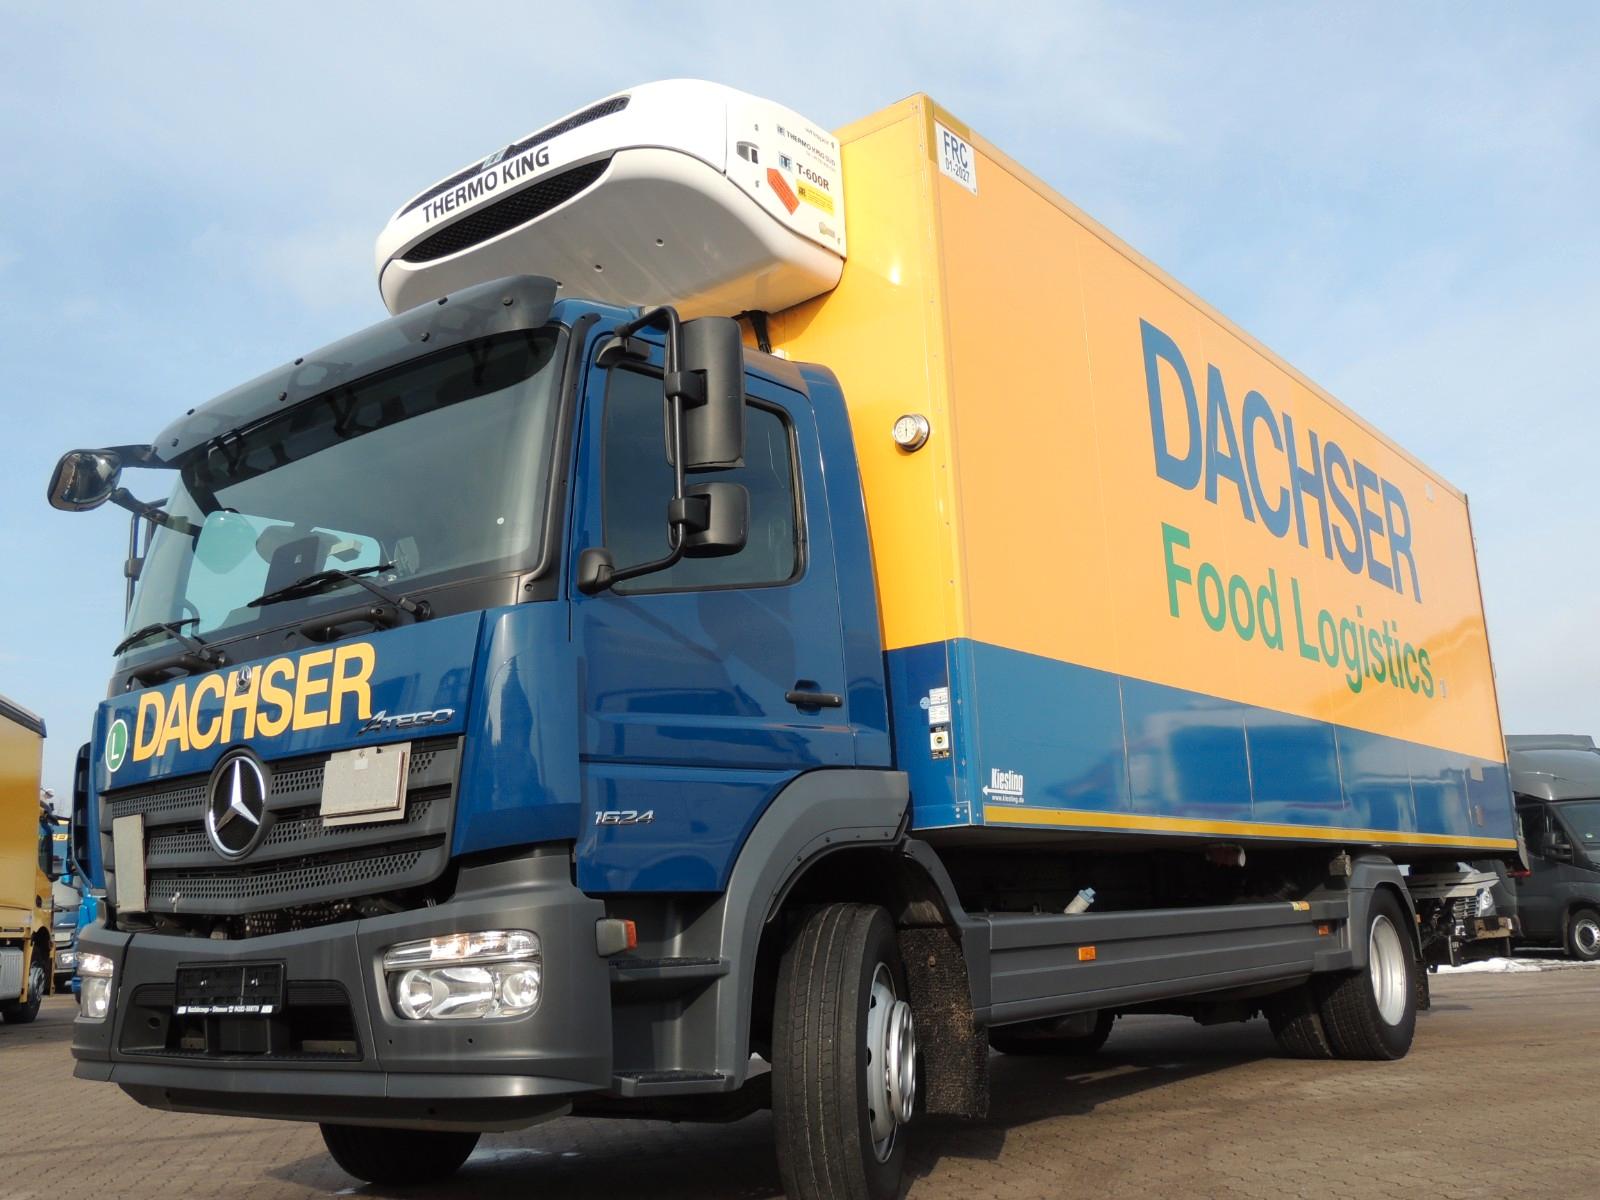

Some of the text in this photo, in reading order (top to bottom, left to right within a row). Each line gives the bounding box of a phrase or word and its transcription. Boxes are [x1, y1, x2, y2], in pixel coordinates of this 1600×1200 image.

[943, 130, 968, 169] FRC
[422, 146, 550, 223] THERMO KING
[796, 162, 830, 192] T-600R
[1139, 317, 1422, 604] DACHSER
[1161, 521, 1434, 698] Food Logistics
[132, 642, 376, 762] DACHSER
[111, 732, 119, 760] L
[991, 767, 1023, 793] Kiesling
[595, 810, 655, 825] 1624
